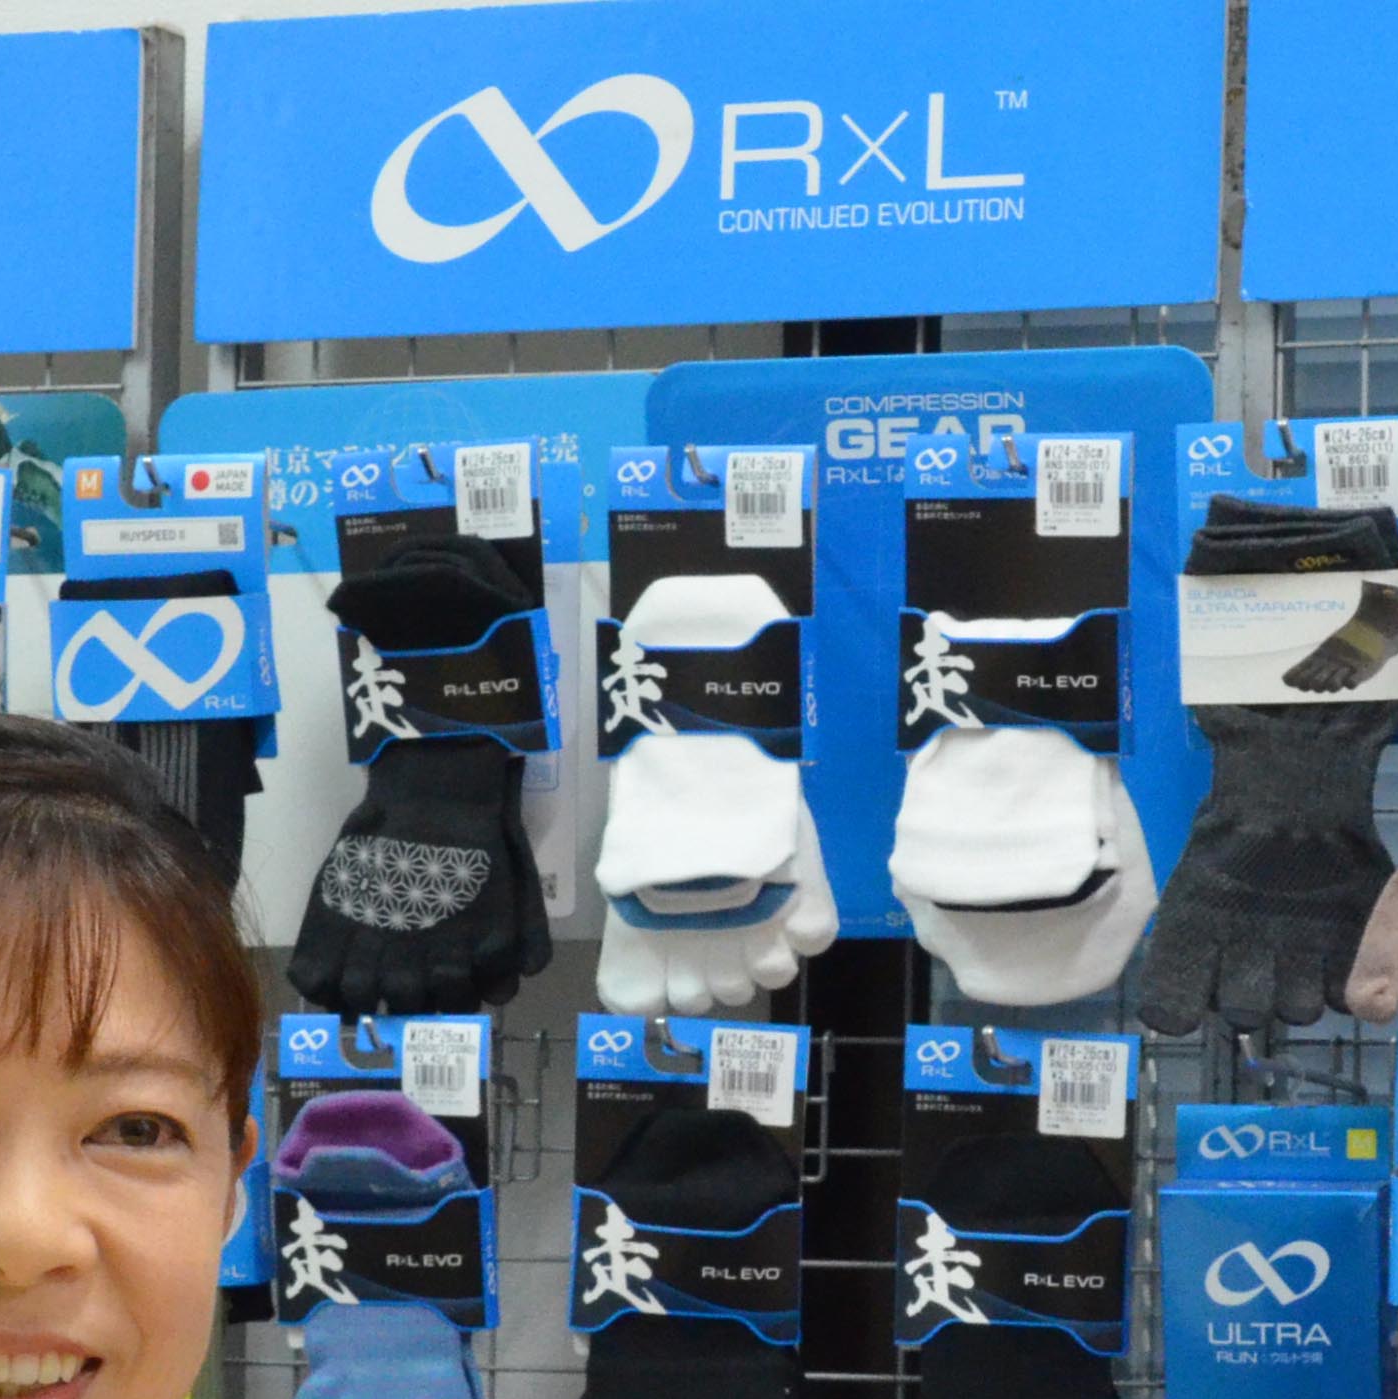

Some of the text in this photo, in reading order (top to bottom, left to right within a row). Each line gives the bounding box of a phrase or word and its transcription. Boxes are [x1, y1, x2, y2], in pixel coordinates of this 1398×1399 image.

[718, 197, 1025, 234] CONTINUED EVOLUTION
[825, 391, 1025, 416] COMPRESSION
[81, 471, 98, 492] M
[215, 469, 249, 482] JAPAN
[215, 481, 247, 492] MADE
[1188, 599, 1347, 616] ULTRA MARATHON
[904, 610, 985, 730] 走
[347, 635, 421, 739] 走
[479, 678, 519, 695] EVO
[602, 626, 679, 737] 走
[742, 680, 783, 696] EVO
[1056, 673, 1100, 689] EVO
[282, 1197, 360, 1305] 走
[422, 1253, 463, 1267] EVO
[583, 1202, 668, 1315] 走
[739, 1266, 782, 1281] EVO
[904, 1212, 991, 1326] 走
[1063, 1273, 1106, 1289] EVO
[1207, 1321, 1332, 1347] ULTRA
[1216, 1350, 1258, 1364] RUN
